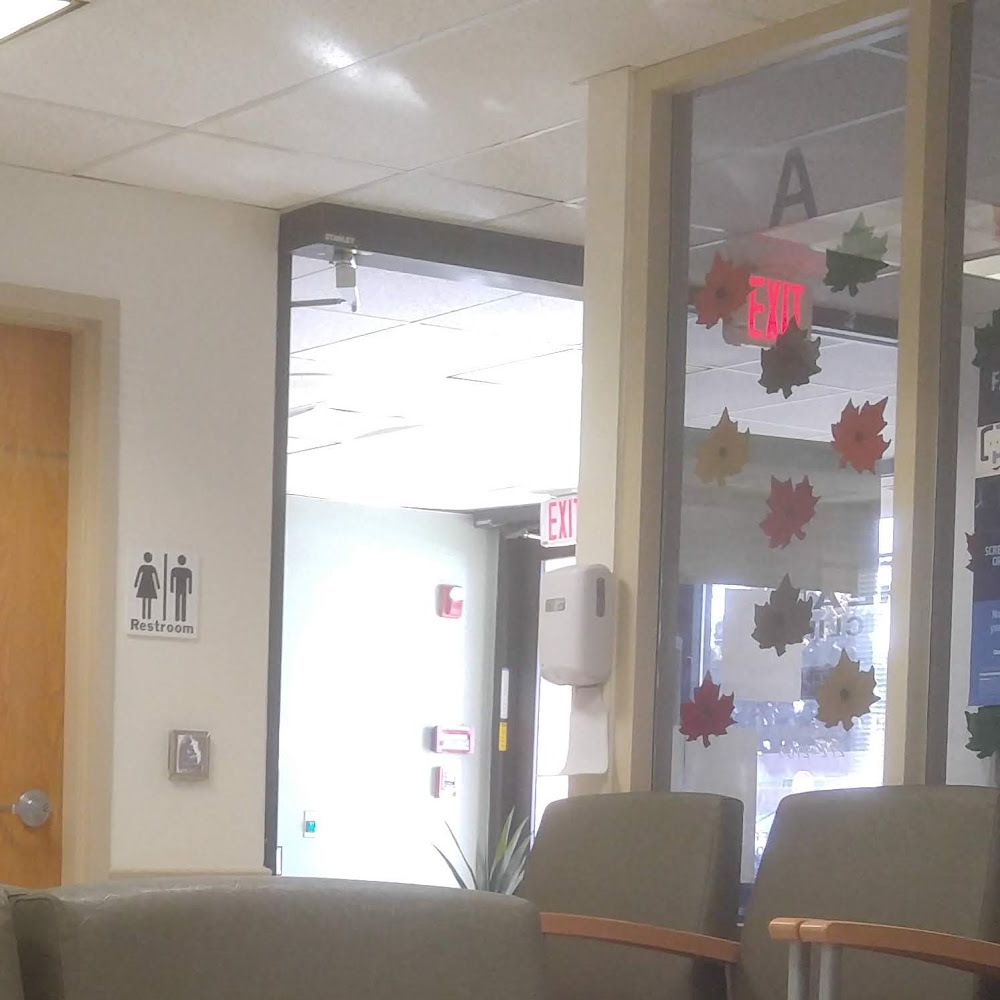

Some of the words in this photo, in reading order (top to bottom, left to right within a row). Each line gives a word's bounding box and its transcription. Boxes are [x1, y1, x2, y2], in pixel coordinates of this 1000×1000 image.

[325, 233, 355, 244] STANLEY
[749, 274, 804, 342] EXIT
[130, 618, 194, 634] Restroom
